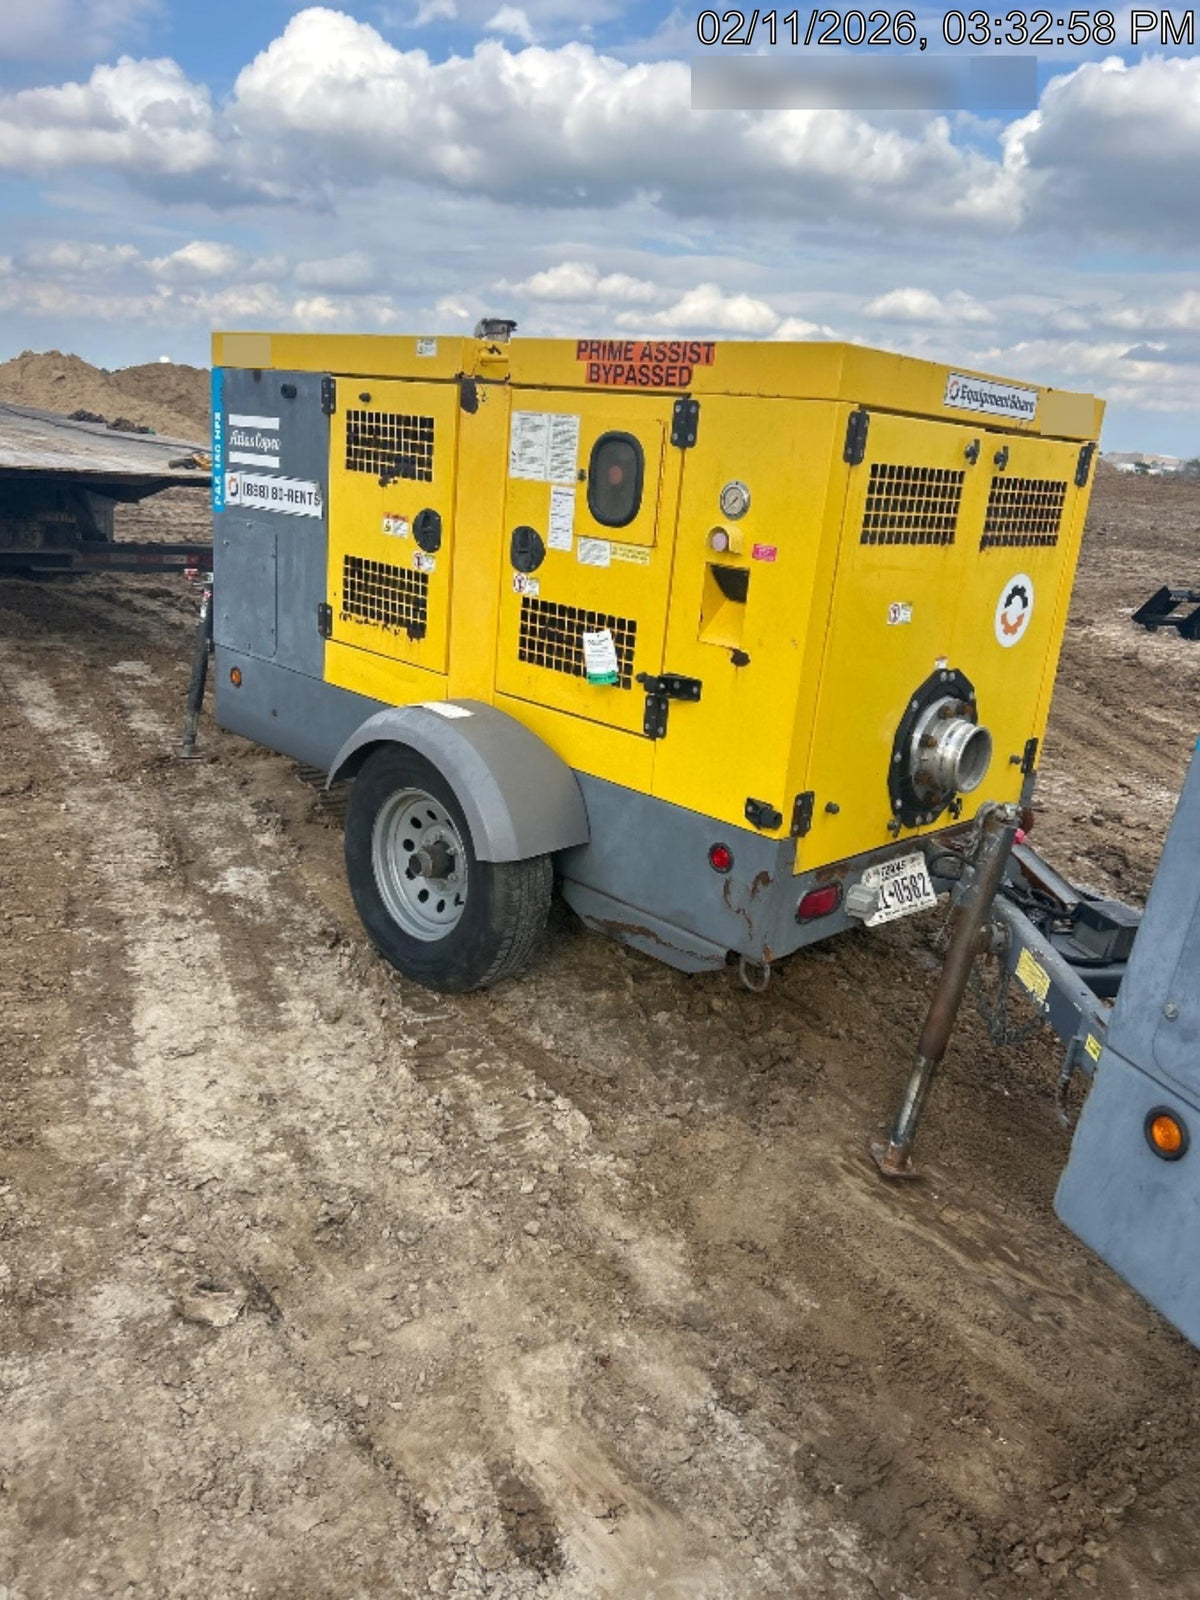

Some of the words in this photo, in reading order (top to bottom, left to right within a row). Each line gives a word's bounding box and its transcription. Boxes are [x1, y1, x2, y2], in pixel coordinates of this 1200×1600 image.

[577, 340, 636, 361] PRIME
[640, 341, 716, 364] ASSIST
[589, 362, 693, 387] BYPASSED
